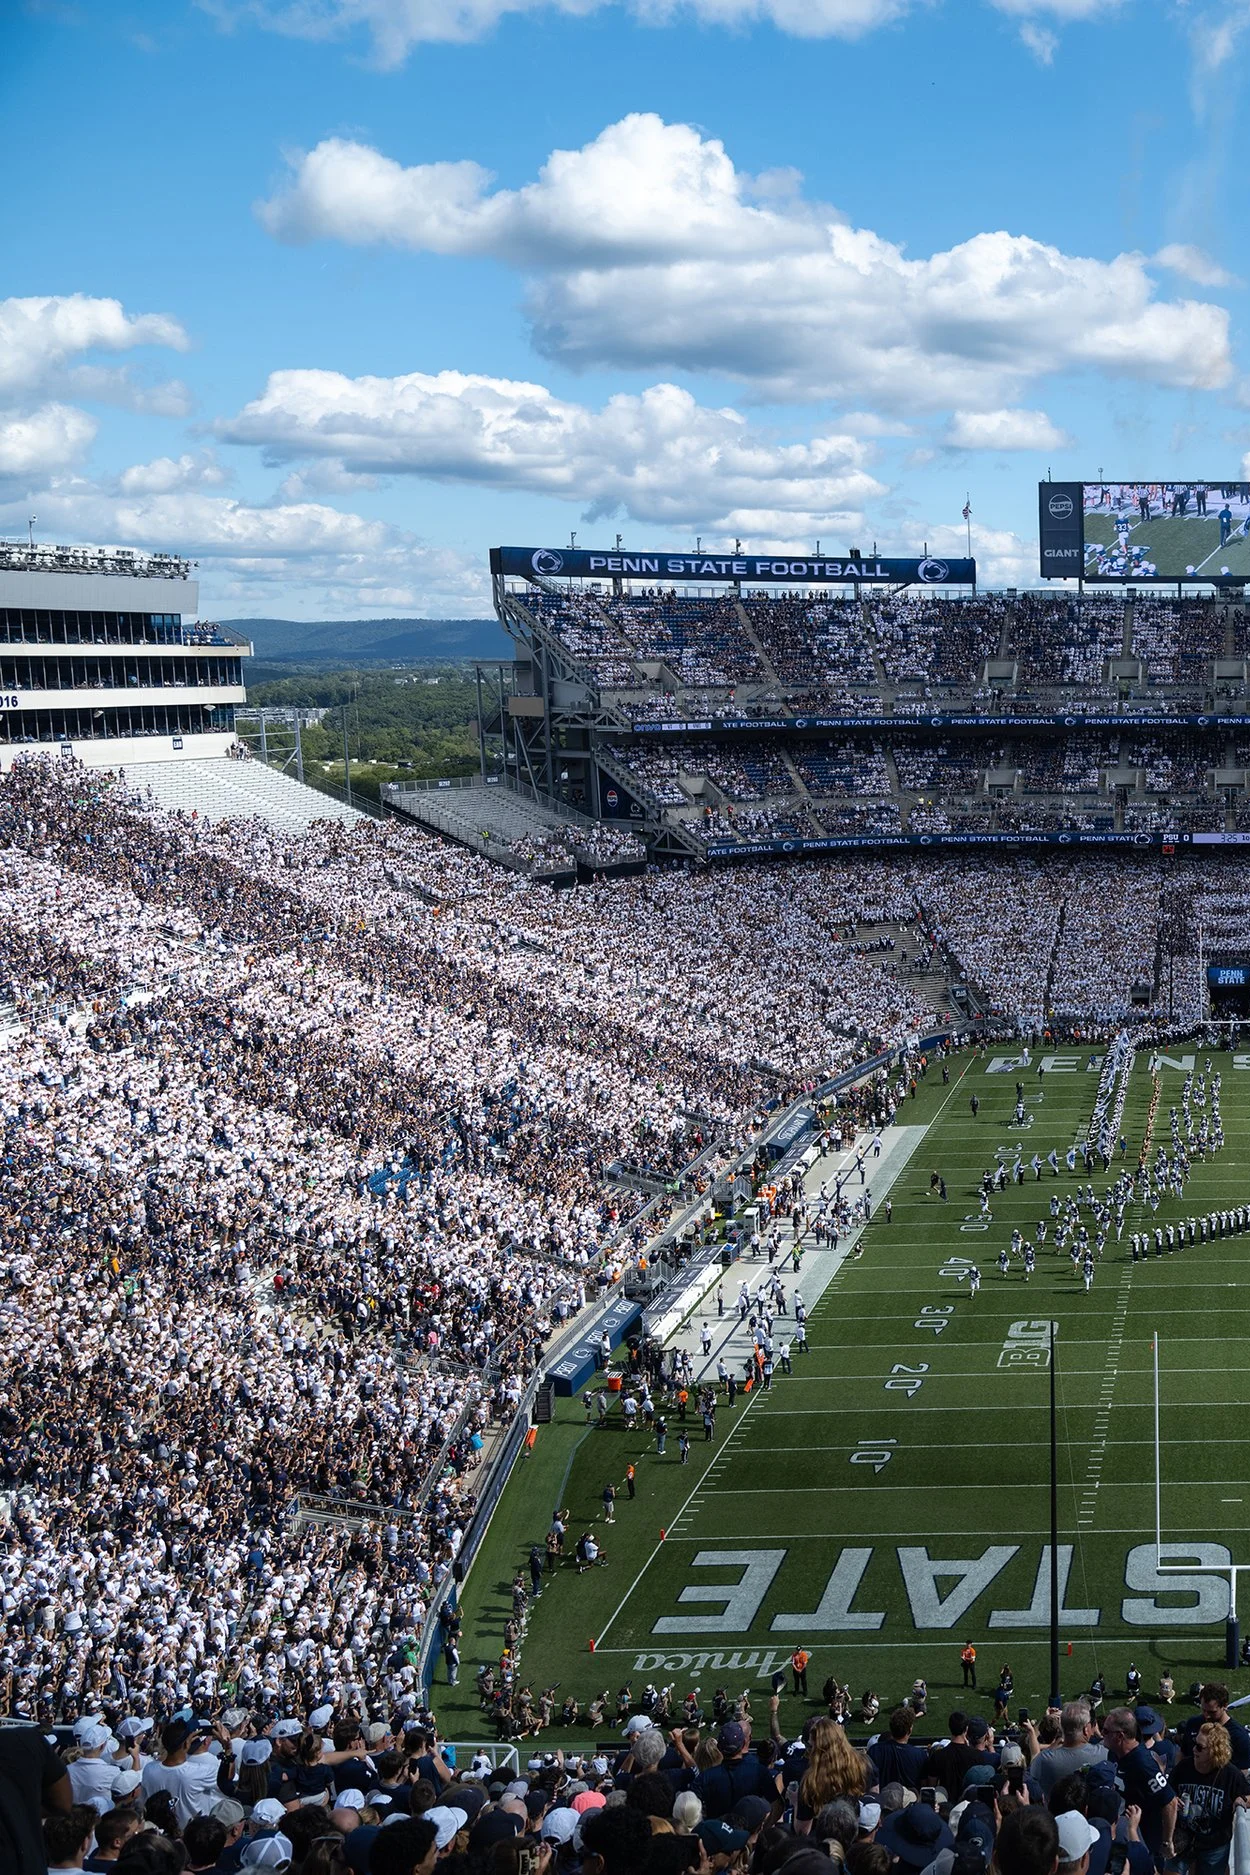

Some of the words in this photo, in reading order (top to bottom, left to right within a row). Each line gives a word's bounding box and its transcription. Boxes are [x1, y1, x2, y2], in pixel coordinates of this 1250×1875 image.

[1044, 549, 1079, 557] GIANT
[589, 556, 660, 573] PENN
[667, 559, 747, 575] STATE
[755, 562, 890, 577] FOOTBALL
[729, 845, 773, 854] FOOTBALL
[985, 1055, 1206, 1073] PEN
[914, 1305, 955, 1329] 30
[884, 1362, 930, 1390] 20
[849, 1438, 899, 1464] 10
[650, 1541, 1234, 1635] STATE
[632, 1650, 813, 1678] Amica
[1147, 1771, 1168, 1794] 26
